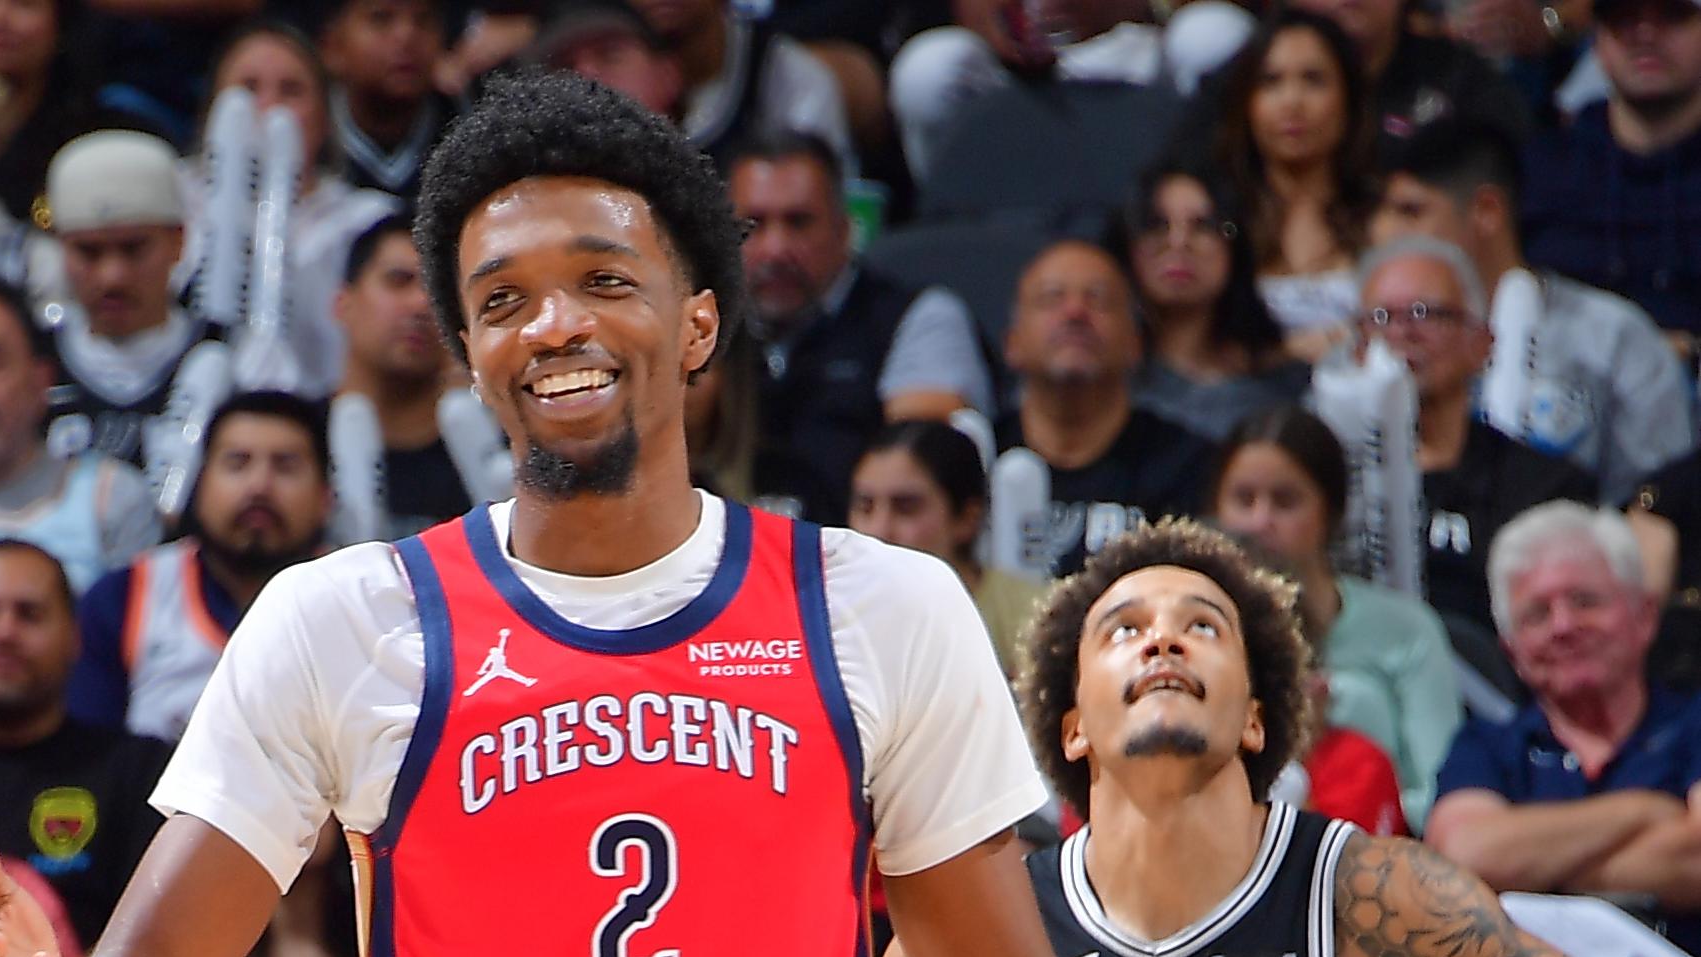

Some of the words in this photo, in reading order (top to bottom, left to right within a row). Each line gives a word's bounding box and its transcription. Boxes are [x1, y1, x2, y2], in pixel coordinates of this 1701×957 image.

[688, 639, 802, 662] NEWAGE
[700, 663, 792, 676] PRODUCTS
[459, 692, 798, 814] CRESCENT
